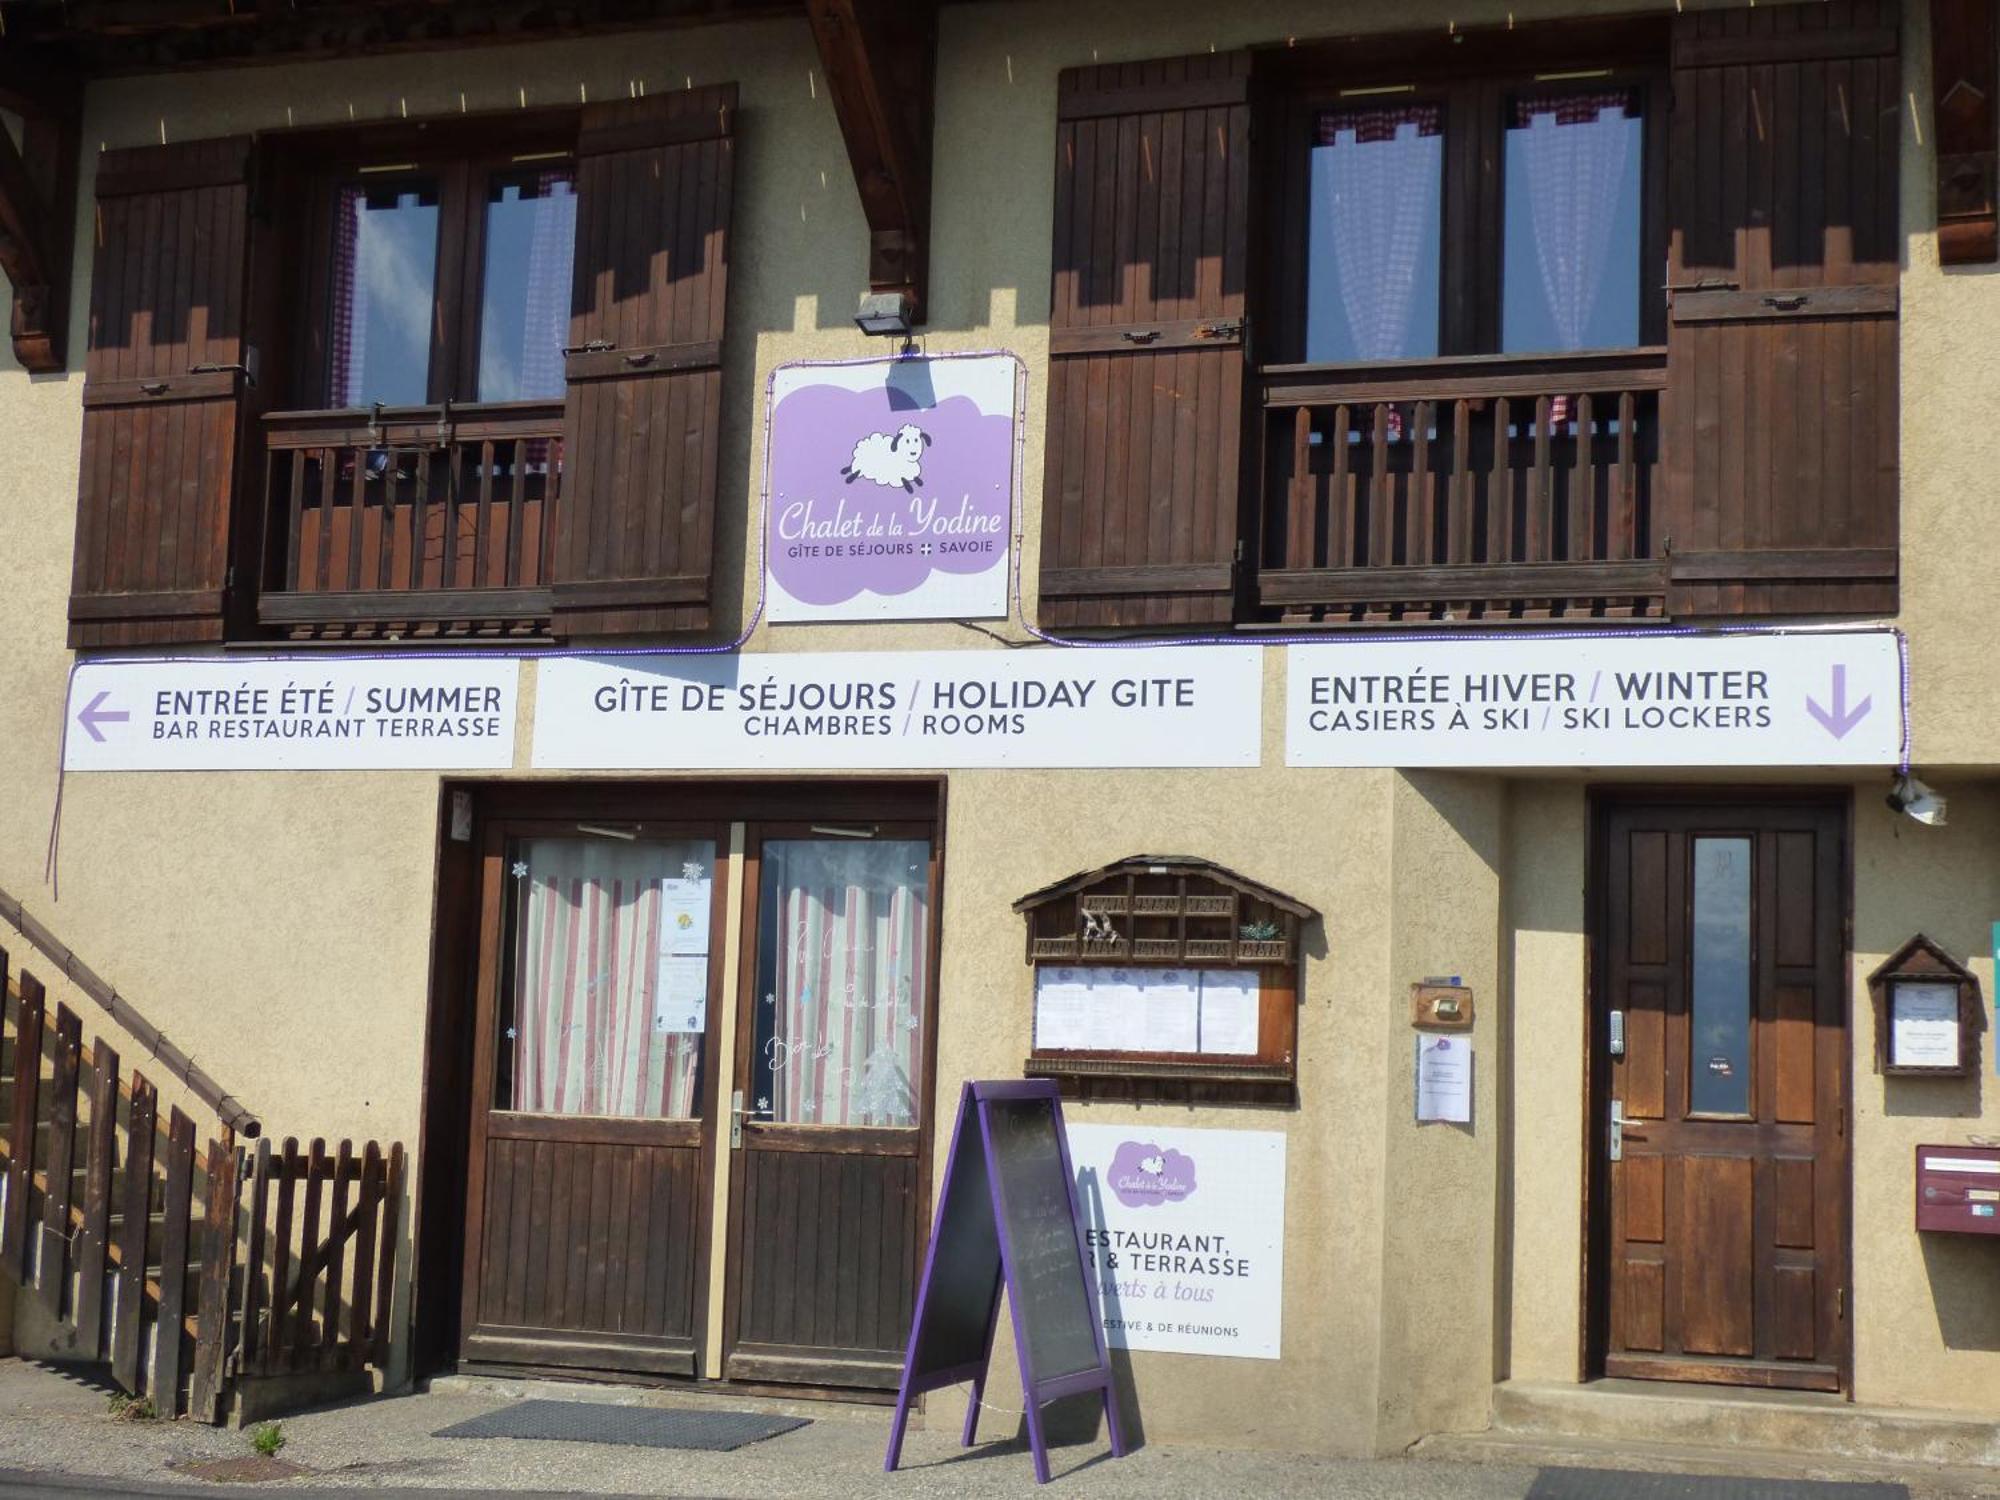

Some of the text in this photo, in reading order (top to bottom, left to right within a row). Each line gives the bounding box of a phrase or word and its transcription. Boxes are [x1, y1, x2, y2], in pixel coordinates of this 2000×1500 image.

[779, 494, 1001, 539] Chalet de la Yodine
[788, 541, 992, 557] GÎTE DE SÉJOURS SAVOIE
[156, 683, 268, 715] ENTRÉE
[281, 681, 333, 713] ÉTÉ
[367, 687, 500, 713] SUMMER
[595, 678, 669, 712] GÎTE
[683, 683, 726, 711] DE
[909, 680, 920, 711] /
[934, 680, 1095, 708] HOLIDAY
[1112, 679, 1193, 707] GITE
[1312, 667, 1449, 704] ENTRÉE
[1465, 674, 1575, 702] HIVER
[1615, 671, 1768, 700] WINTER
[154, 718, 499, 739] BAR RESTAURANT TERRASSE
[745, 716, 891, 735] CHAMBRES
[924, 715, 1024, 734] ROOMS
[1310, 710, 1434, 731] CASIERS
[1449, 703, 1469, 729] À
[1484, 709, 1528, 729] SKI
[1564, 708, 1609, 729] SKI
[1625, 706, 1770, 728] LOCKERS
[1086, 1229, 1229, 1256] ESTAURANT,
[1130, 1252, 1249, 1277] TERRASSE
[1174, 1280, 1214, 1303] tous
[1103, 1319, 1142, 1332] ESTIVE
[1158, 1323, 1173, 1334] DE
